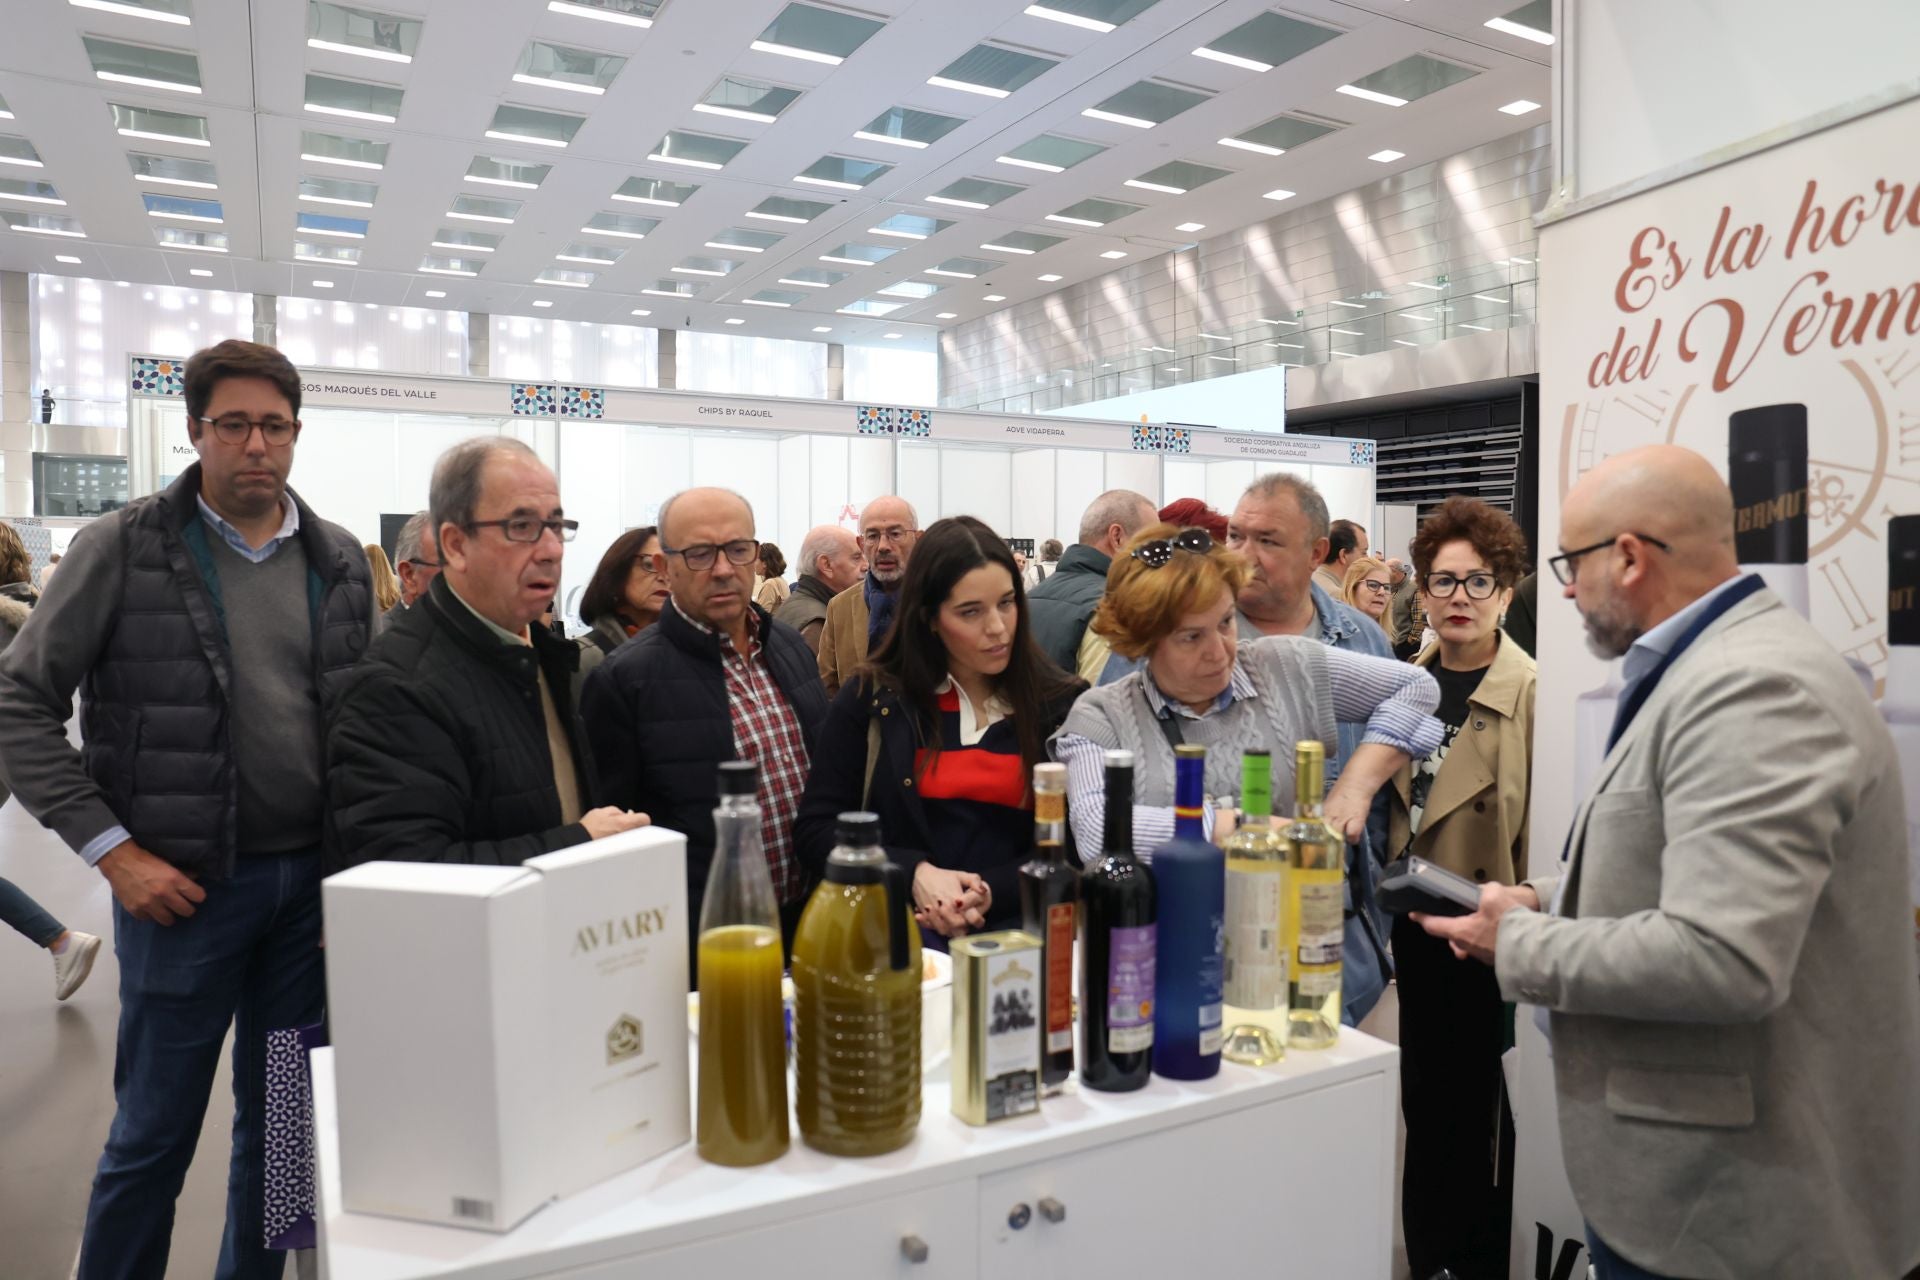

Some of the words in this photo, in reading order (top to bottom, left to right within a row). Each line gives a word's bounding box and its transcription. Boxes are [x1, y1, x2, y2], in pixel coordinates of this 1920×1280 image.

[1613, 226, 1691, 313] Es
[1703, 205, 1771, 280] la
[1587, 318, 1661, 388] del
[324, 385, 378, 396] MARQUÉS
[380, 388, 401, 397] DEL
[404, 389, 437, 399] VALLE
[698, 406, 724, 415] CHIPS
[739, 408, 773, 418] RAQUEL
[1005, 426, 1025, 434] AOVE
[1026, 427, 1065, 436] VIDAPERRA
[1224, 436, 1253, 445] SOCIEDAD
[1253, 439, 1291, 447] COOPERATIVA
[1249, 447, 1277, 455] CONSUMO
[570, 905, 670, 957] AVIARY
